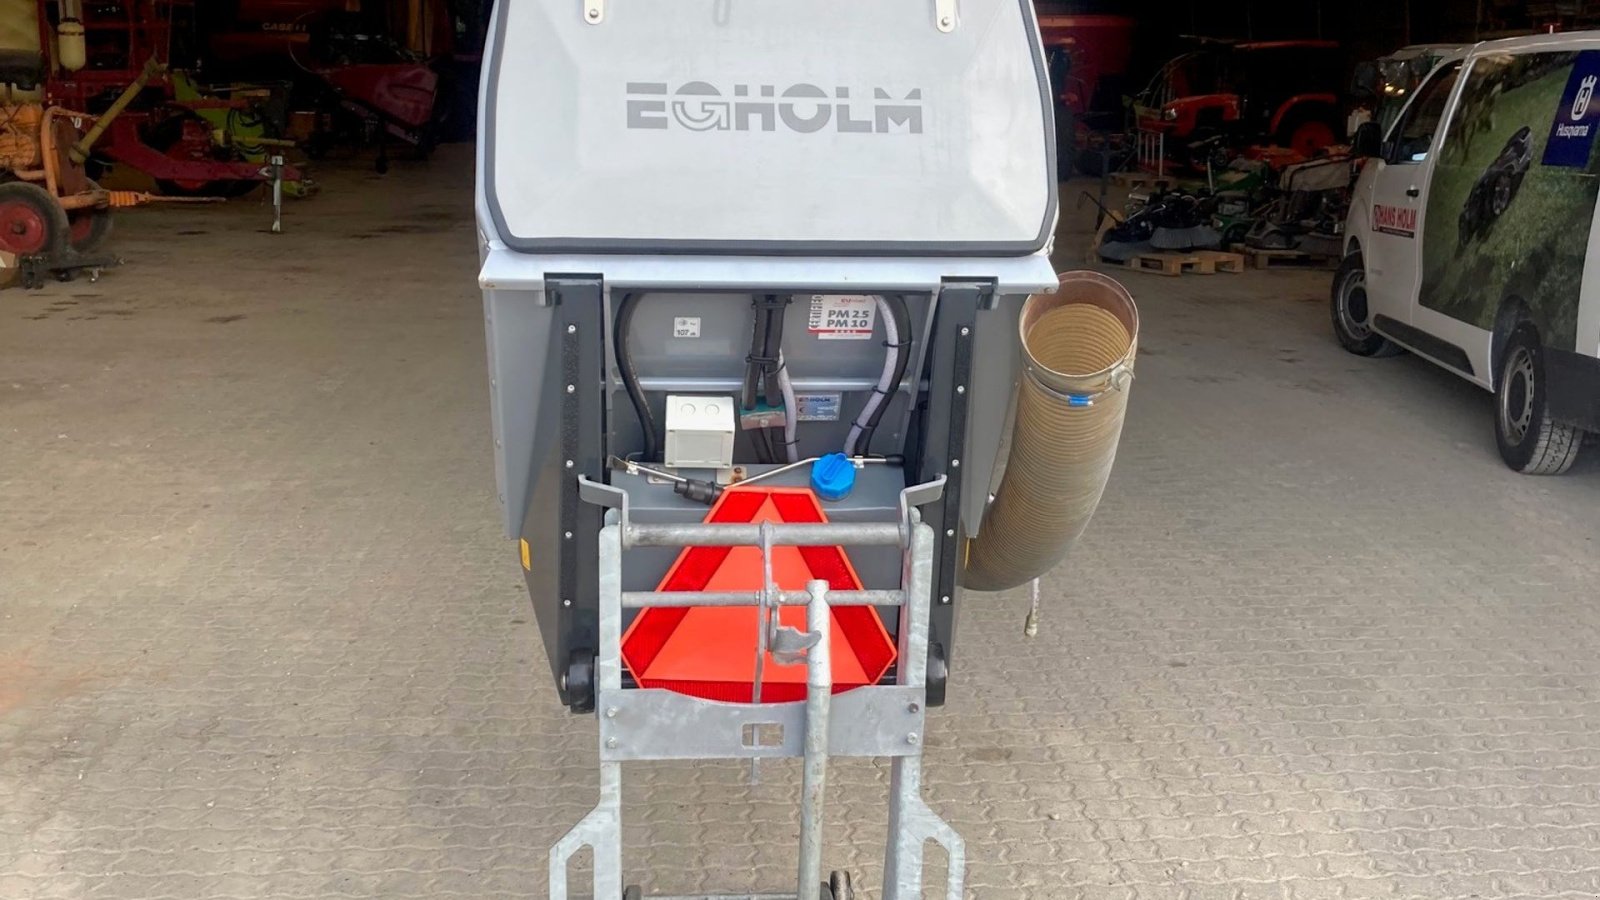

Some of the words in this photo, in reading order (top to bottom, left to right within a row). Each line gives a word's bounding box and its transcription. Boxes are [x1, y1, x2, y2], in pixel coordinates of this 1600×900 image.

[626, 81, 922, 134] EGHOLM
[1556, 122, 1589, 139] Husqvarna
[1379, 205, 1396, 227] HANS
[1397, 207, 1417, 231] HOLM
[828, 309, 849, 318] PM
[826, 319, 848, 328] PM
[850, 319, 868, 328] 10
